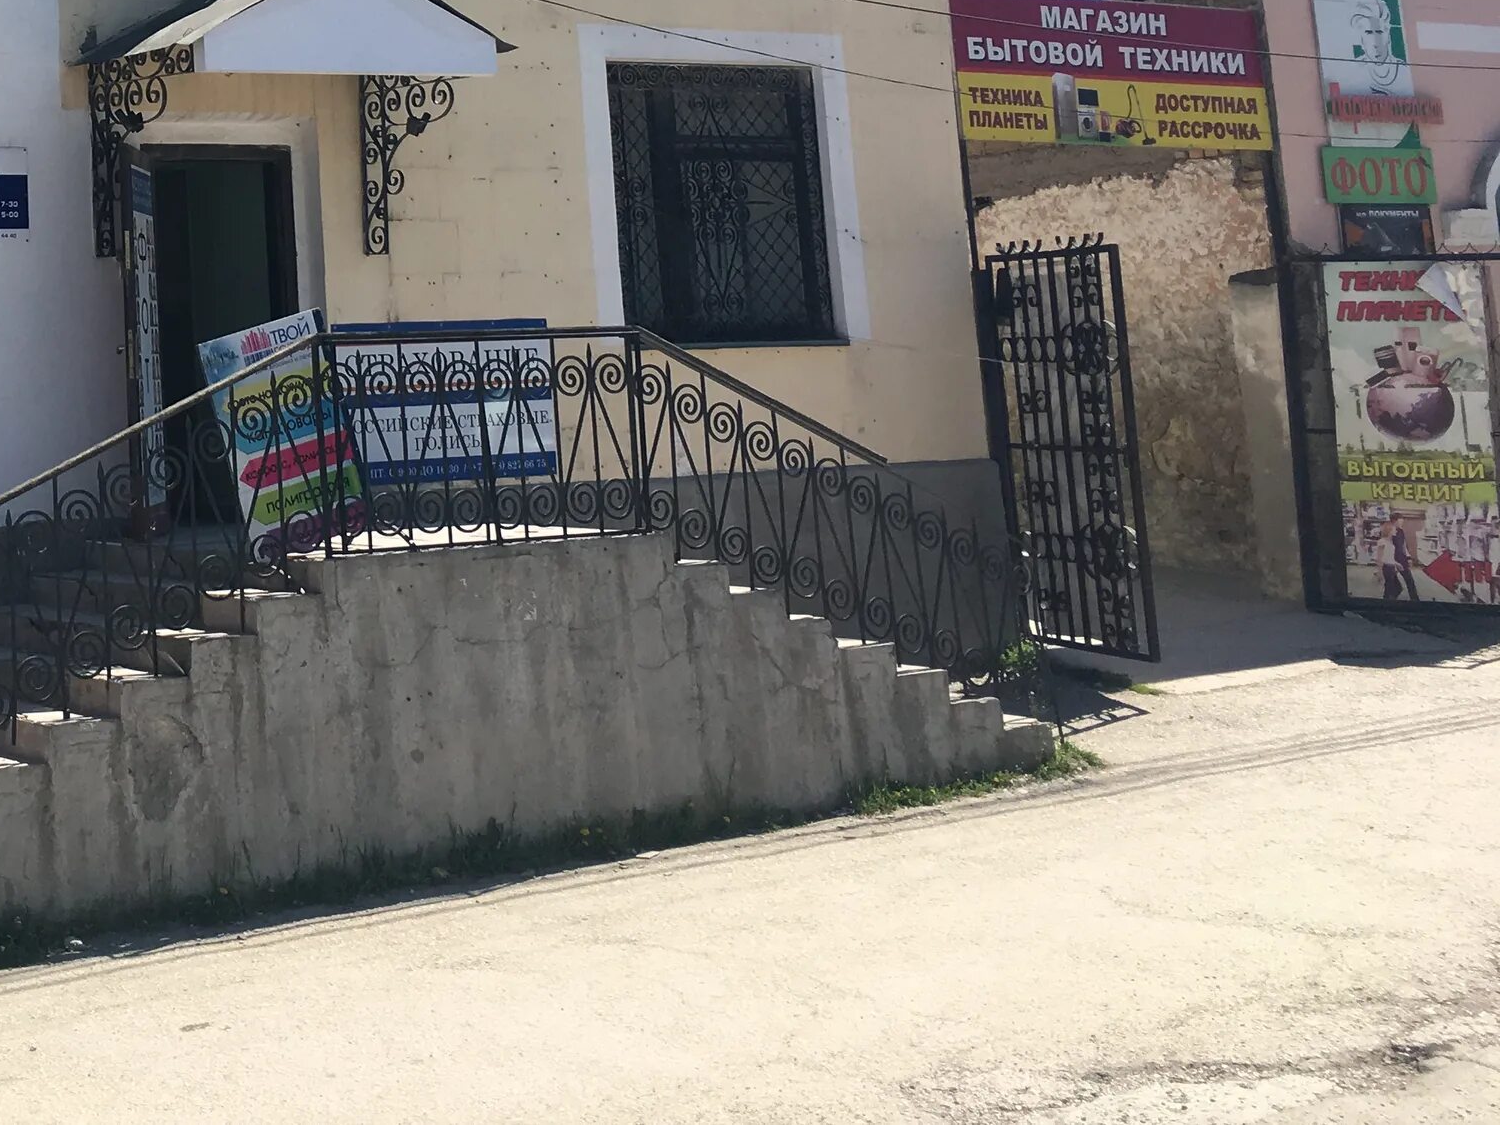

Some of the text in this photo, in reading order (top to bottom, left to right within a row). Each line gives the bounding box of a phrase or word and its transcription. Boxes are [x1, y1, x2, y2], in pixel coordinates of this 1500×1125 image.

[1040, 5, 1167, 36] МАГАЗИН
[967, 36, 1246, 75] БЫТОВОЙ ТЕХНИКИ
[968, 86, 1044, 107] ТЕХНИКА
[1155, 92, 1258, 115] ДОСТУПНАЯ
[969, 110, 1048, 131] ПЛАНЕТЫ
[1158, 119, 1261, 141] РАССРОЧКА
[1331, 157, 1427, 196] ФОТО
[1339, 270, 1426, 292] ТЕХНИ
[270, 316, 311, 345] ТВОЙ
[351, 415, 450, 434] ОССИЙСКИЕ
[1347, 459, 1486, 480] ВЫГОДНЫЙ
[266, 477, 350, 514] полиграфя
[1371, 483, 1465, 502] КРЕДИТ
